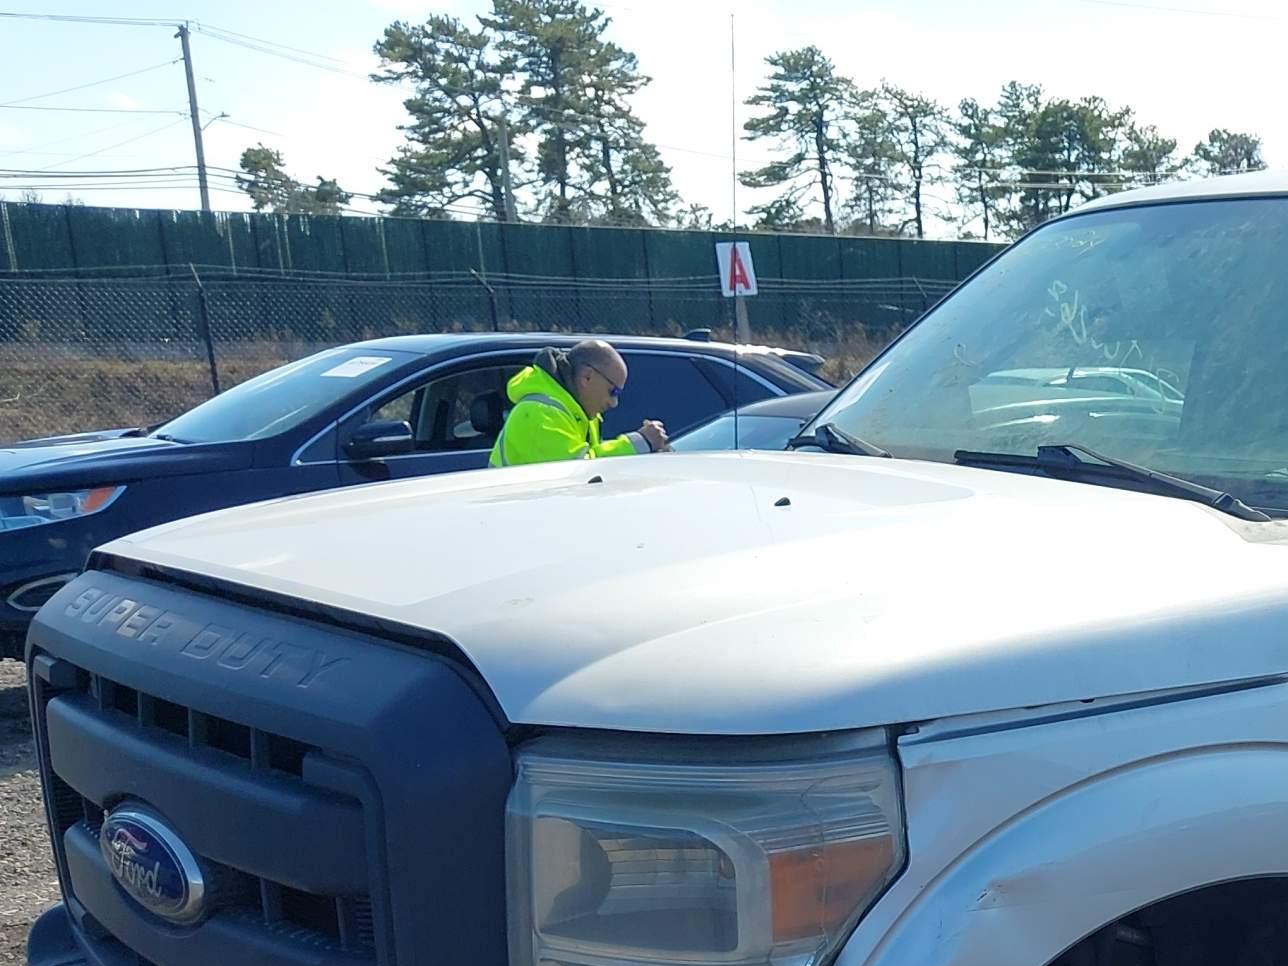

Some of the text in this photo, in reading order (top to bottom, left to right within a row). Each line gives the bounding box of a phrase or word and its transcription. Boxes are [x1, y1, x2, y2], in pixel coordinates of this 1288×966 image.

[729, 246, 752, 291] A
[64, 587, 352, 689] SUPER DUTY
[108, 827, 163, 899] Ford
